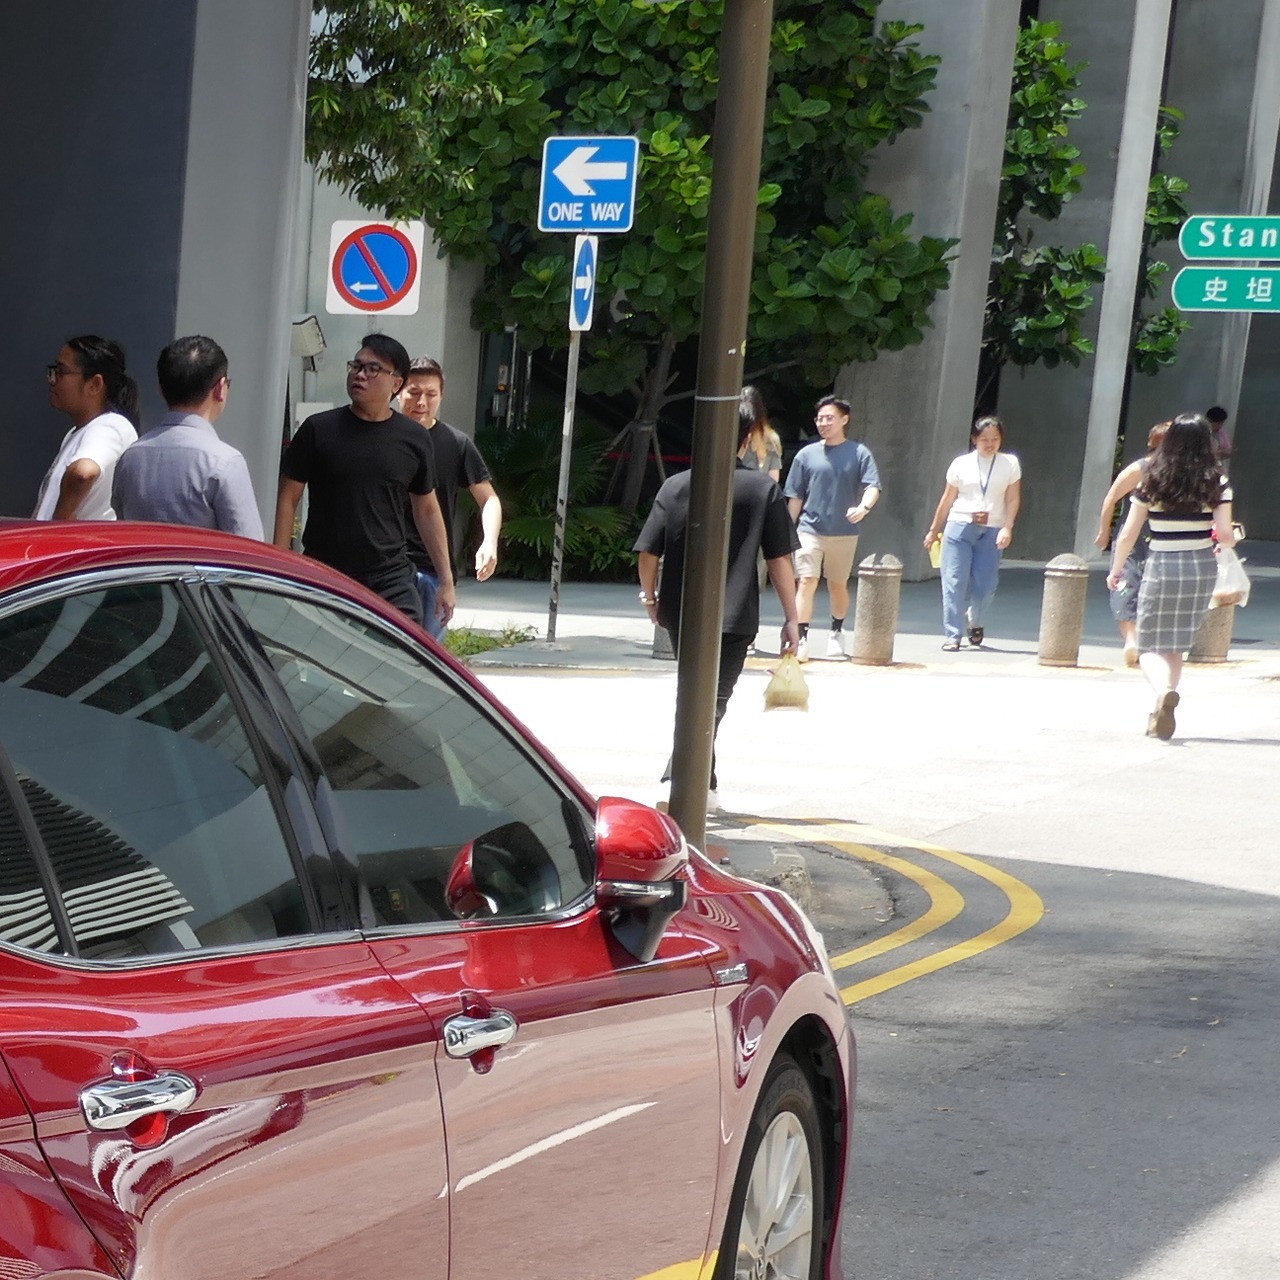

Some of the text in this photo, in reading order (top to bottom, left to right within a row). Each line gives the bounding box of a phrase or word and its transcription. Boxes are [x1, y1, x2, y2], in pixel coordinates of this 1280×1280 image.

[548, 202, 624, 221] ONE WAY
[1198, 220, 1278, 248] Stan
[1202, 276, 1273, 303] 史坦
